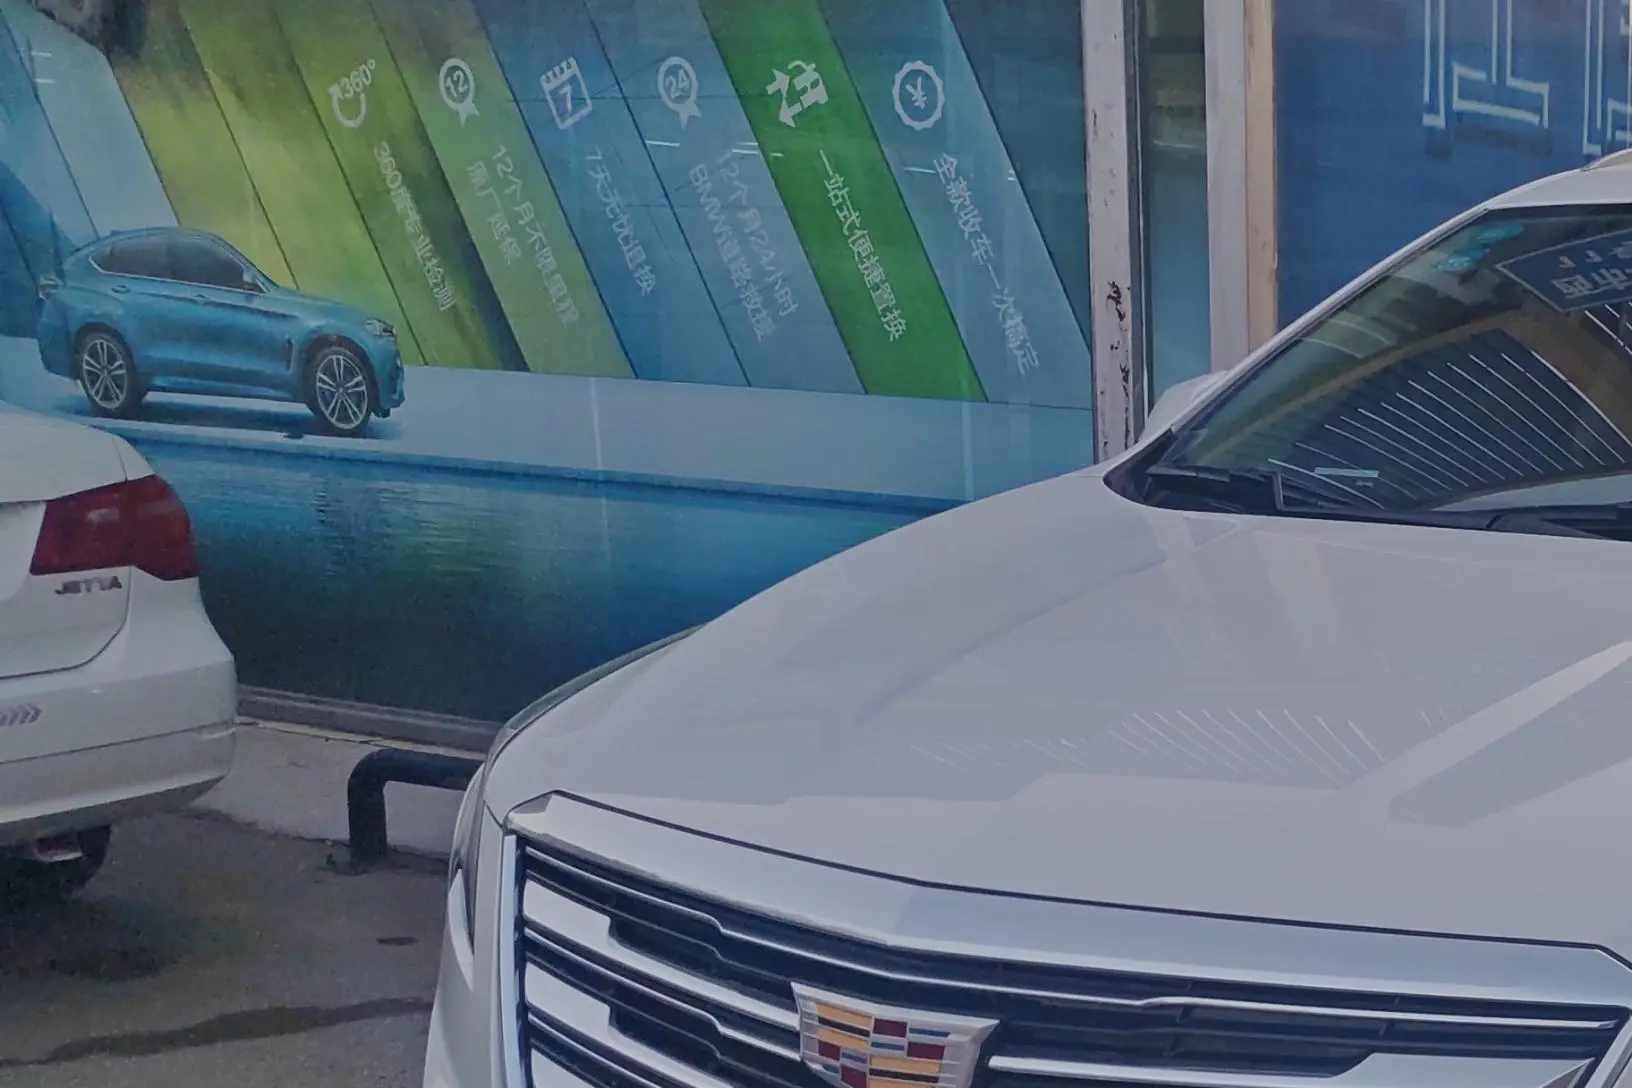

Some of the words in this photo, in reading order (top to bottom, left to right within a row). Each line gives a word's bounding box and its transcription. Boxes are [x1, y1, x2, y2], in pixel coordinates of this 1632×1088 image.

[664, 68, 691, 100] 24
[373, 141, 457, 312] 360度专业检测
[466, 160, 522, 266] 原厂延保
[491, 145, 581, 328] 12个月不限里程
[584, 146, 657, 297] 7天无忧退换
[717, 150, 800, 318] 12个月24小时
[817, 148, 908, 343] 一站式便捷置换
[932, 151, 1040, 377] 全款收车一次搞定
[54, 574, 123, 596] JETTA
